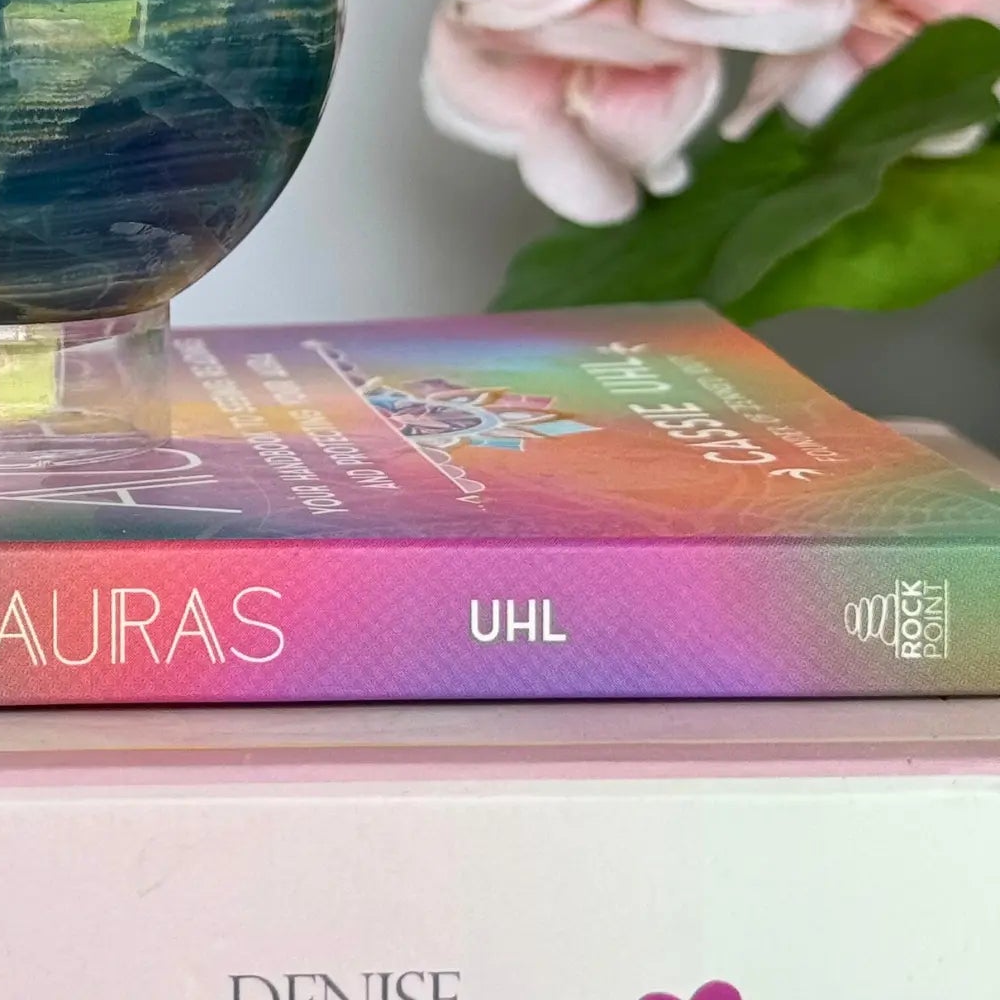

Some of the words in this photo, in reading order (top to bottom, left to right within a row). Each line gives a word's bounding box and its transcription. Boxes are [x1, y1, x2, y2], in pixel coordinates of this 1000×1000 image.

[580, 357, 672, 394] UHL
[628, 402, 776, 465] CASSIE
[291, 485, 349, 515] YOUR
[346, 468, 399, 489] AND
[469, 598, 567, 643] UHL
[901, 579, 922, 659] ROCK
[924, 579, 943, 659] POINT
